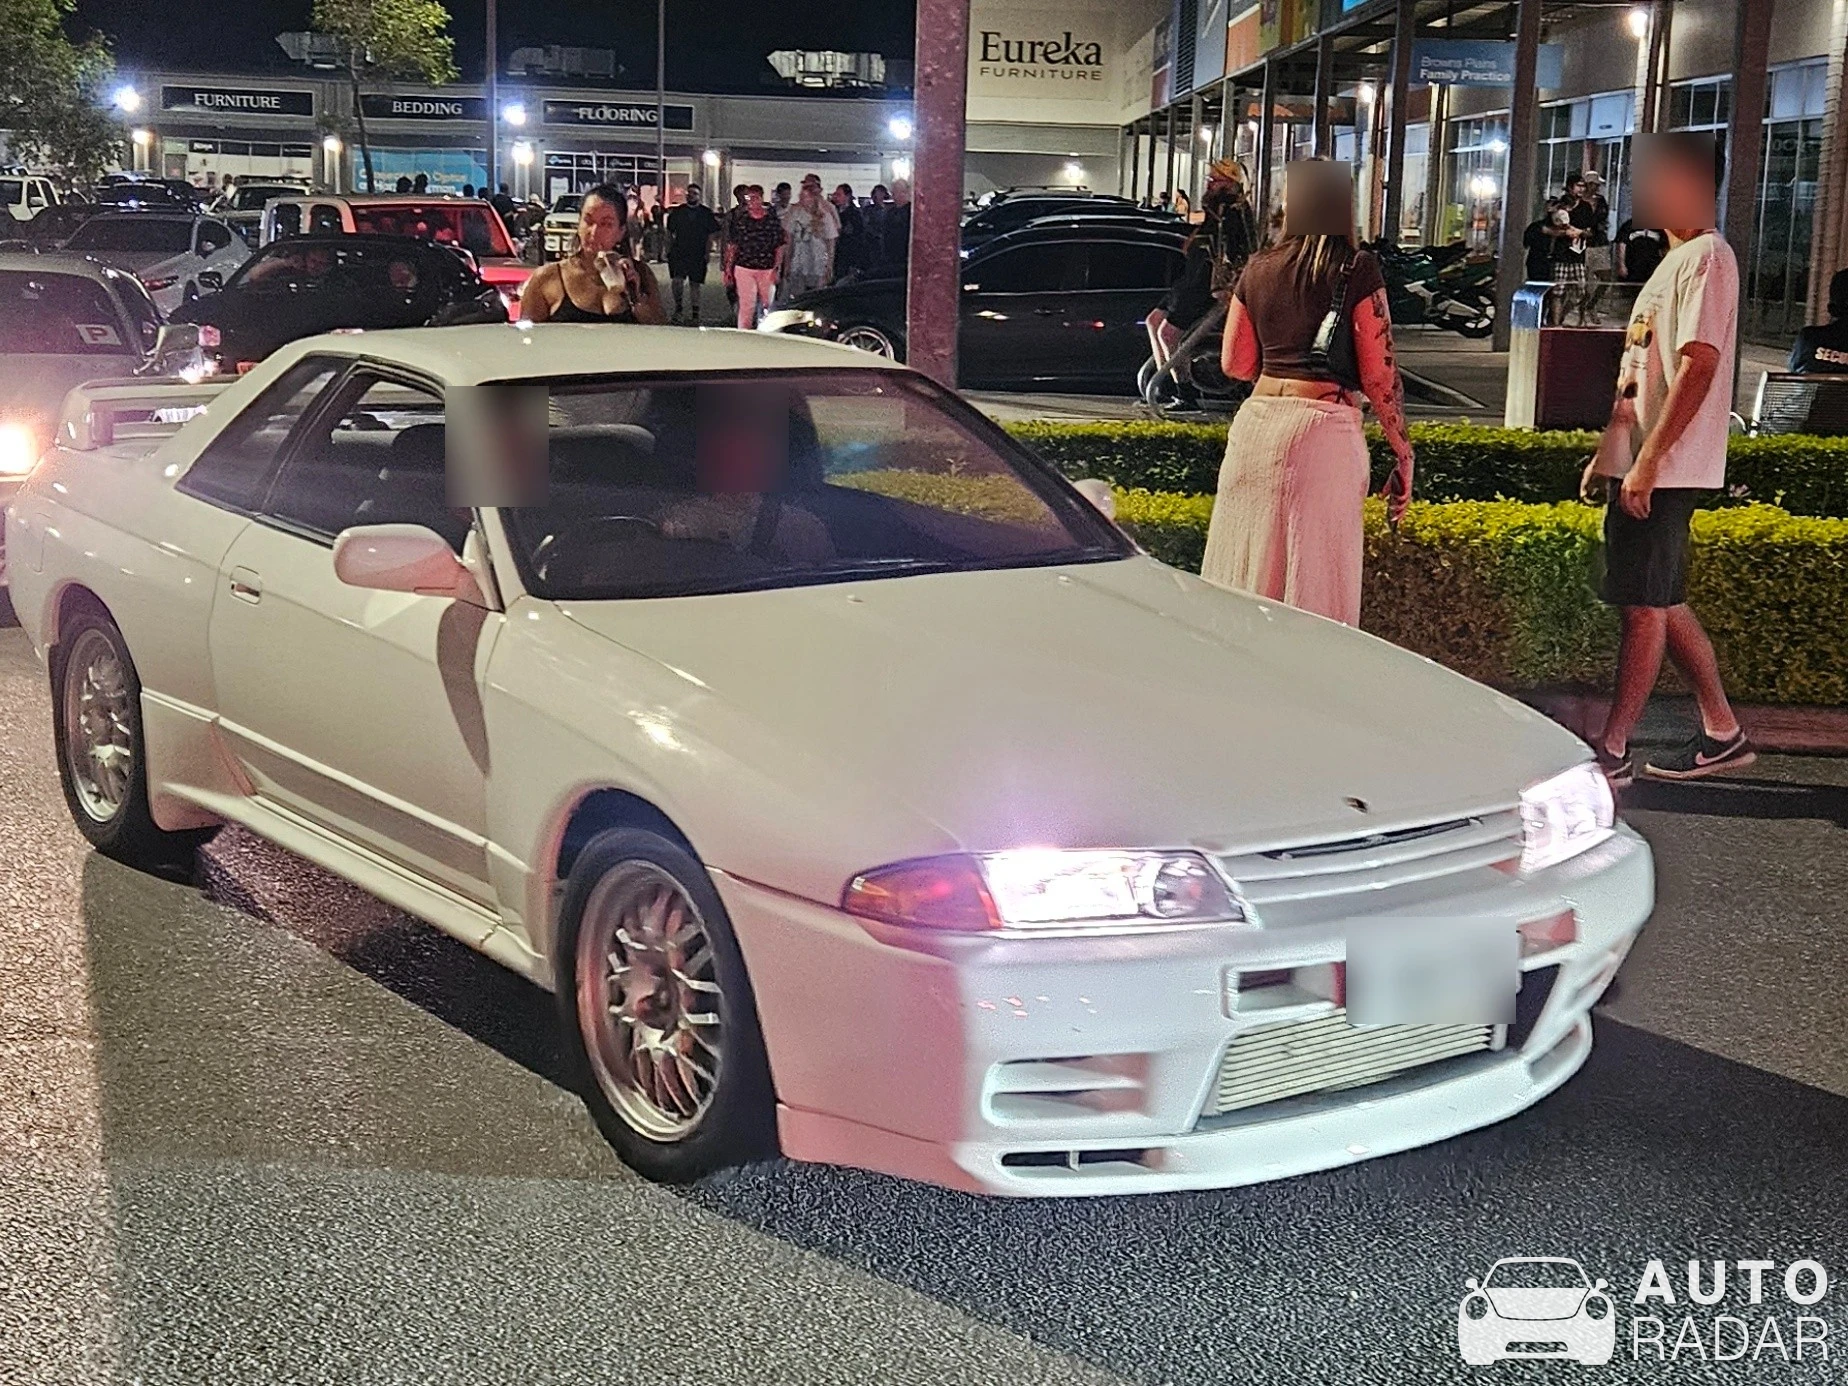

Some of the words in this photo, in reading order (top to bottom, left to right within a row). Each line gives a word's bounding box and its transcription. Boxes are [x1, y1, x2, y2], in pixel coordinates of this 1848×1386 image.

[979, 30, 1104, 66] Eureka
[1421, 56, 1463, 68] Browns
[979, 66, 1103, 80] FURNITURE
[1420, 68, 1459, 82] Family
[1461, 70, 1511, 81] Practice
[193, 93, 281, 109] FURNITURE
[391, 101, 463, 115] BEDDING
[578, 106, 659, 122] FLOORING
